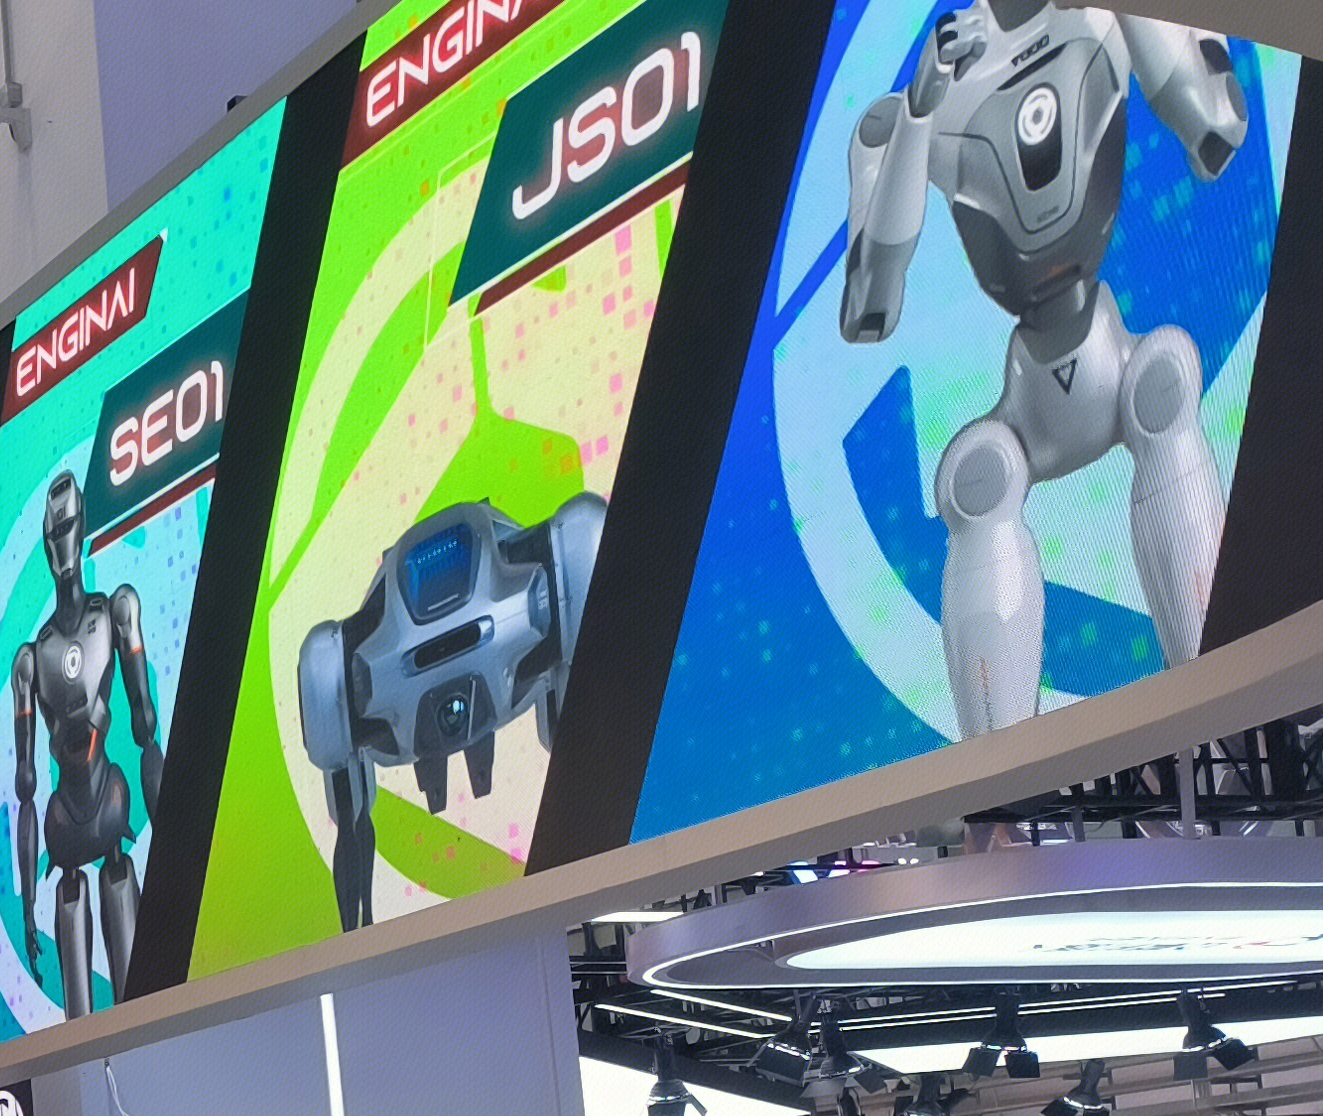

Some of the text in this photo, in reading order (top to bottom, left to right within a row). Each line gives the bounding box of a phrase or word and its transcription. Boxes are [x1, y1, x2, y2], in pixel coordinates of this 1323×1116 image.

[513, 31, 700, 220] JS01
[15, 268, 135, 396] ENGINAI
[109, 361, 224, 486] SE01
